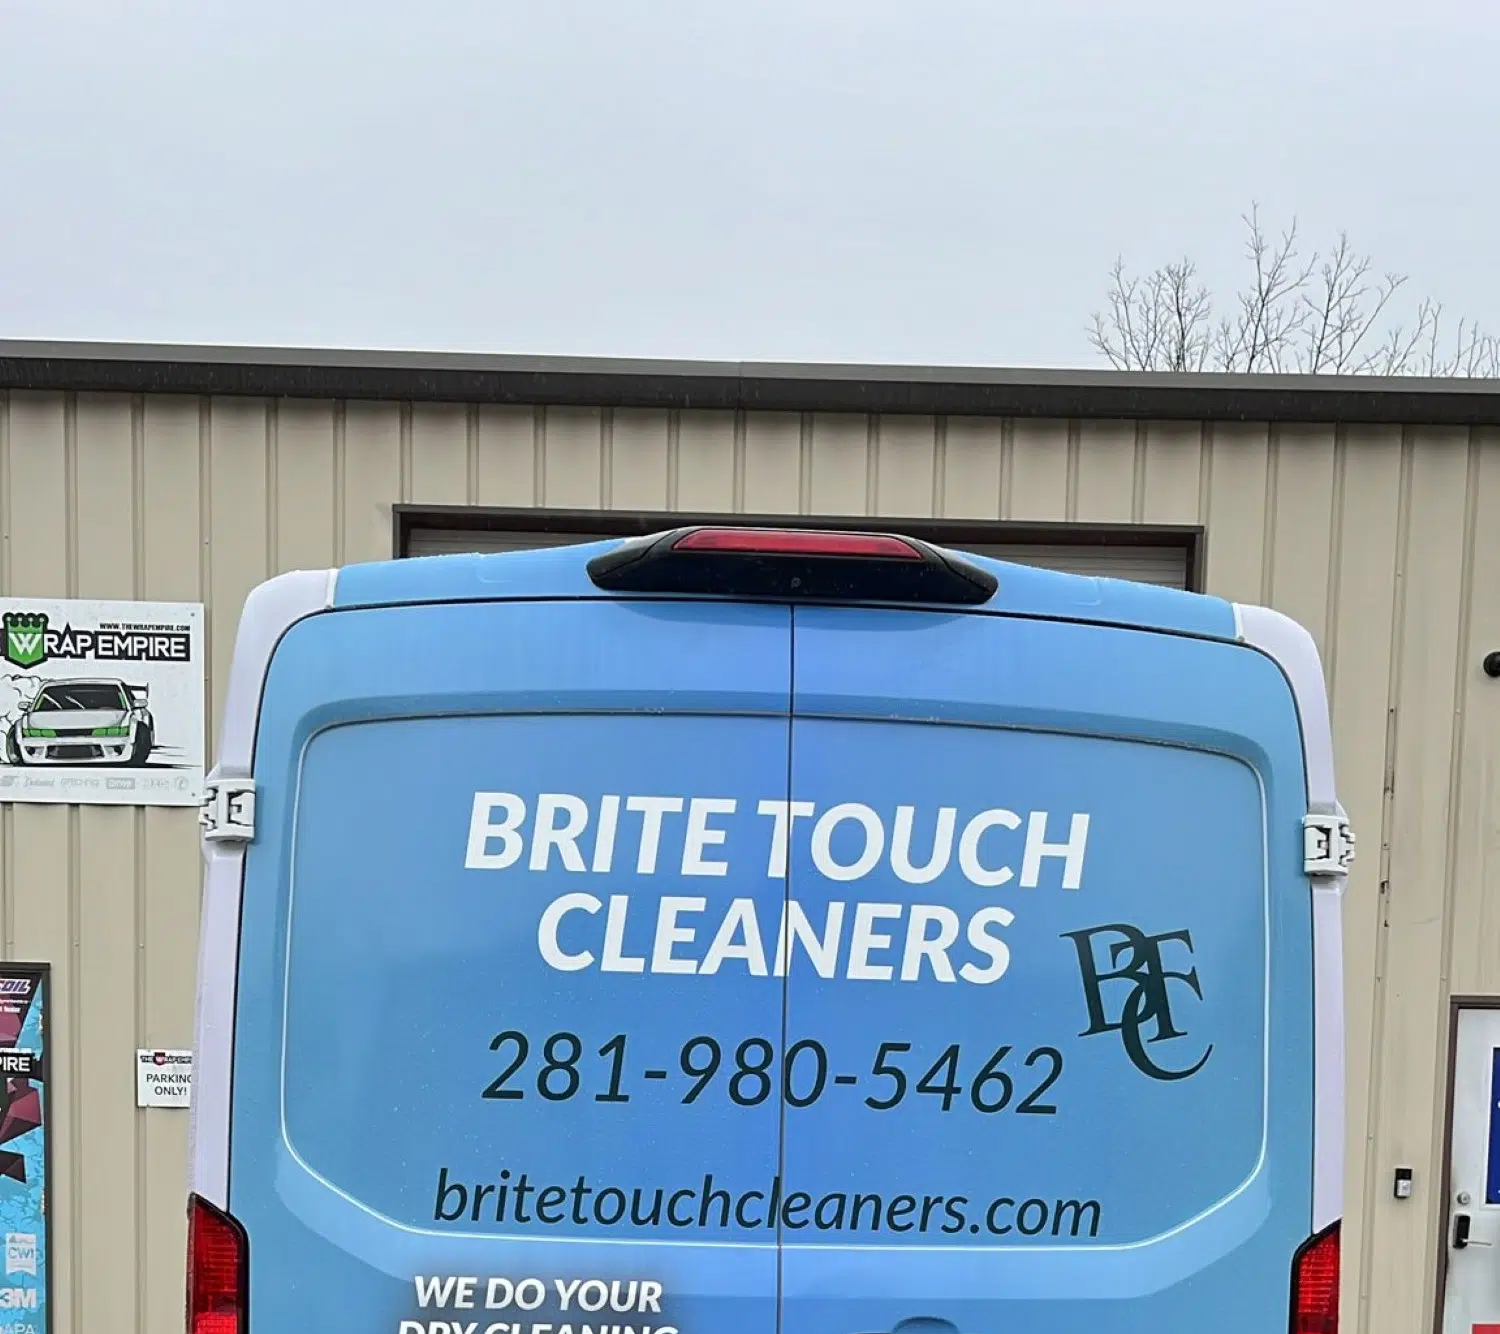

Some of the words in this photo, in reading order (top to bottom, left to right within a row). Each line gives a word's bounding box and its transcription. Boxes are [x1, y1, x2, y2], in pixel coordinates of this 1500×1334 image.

[98, 634, 187, 658] EMPIRE
[463, 790, 737, 877] BRITE
[757, 799, 1091, 890] TOUCH
[537, 892, 1016, 985] CLEANERS
[154, 1086, 187, 1096] ONLY!
[481, 1029, 1065, 1115] 281-980-5462
[432, 1166, 1102, 1238] britetouchcleaners.com
[414, 1275, 478, 1309] WE
[485, 1277, 546, 1311] DO
[554, 1279, 663, 1313] YOUR
